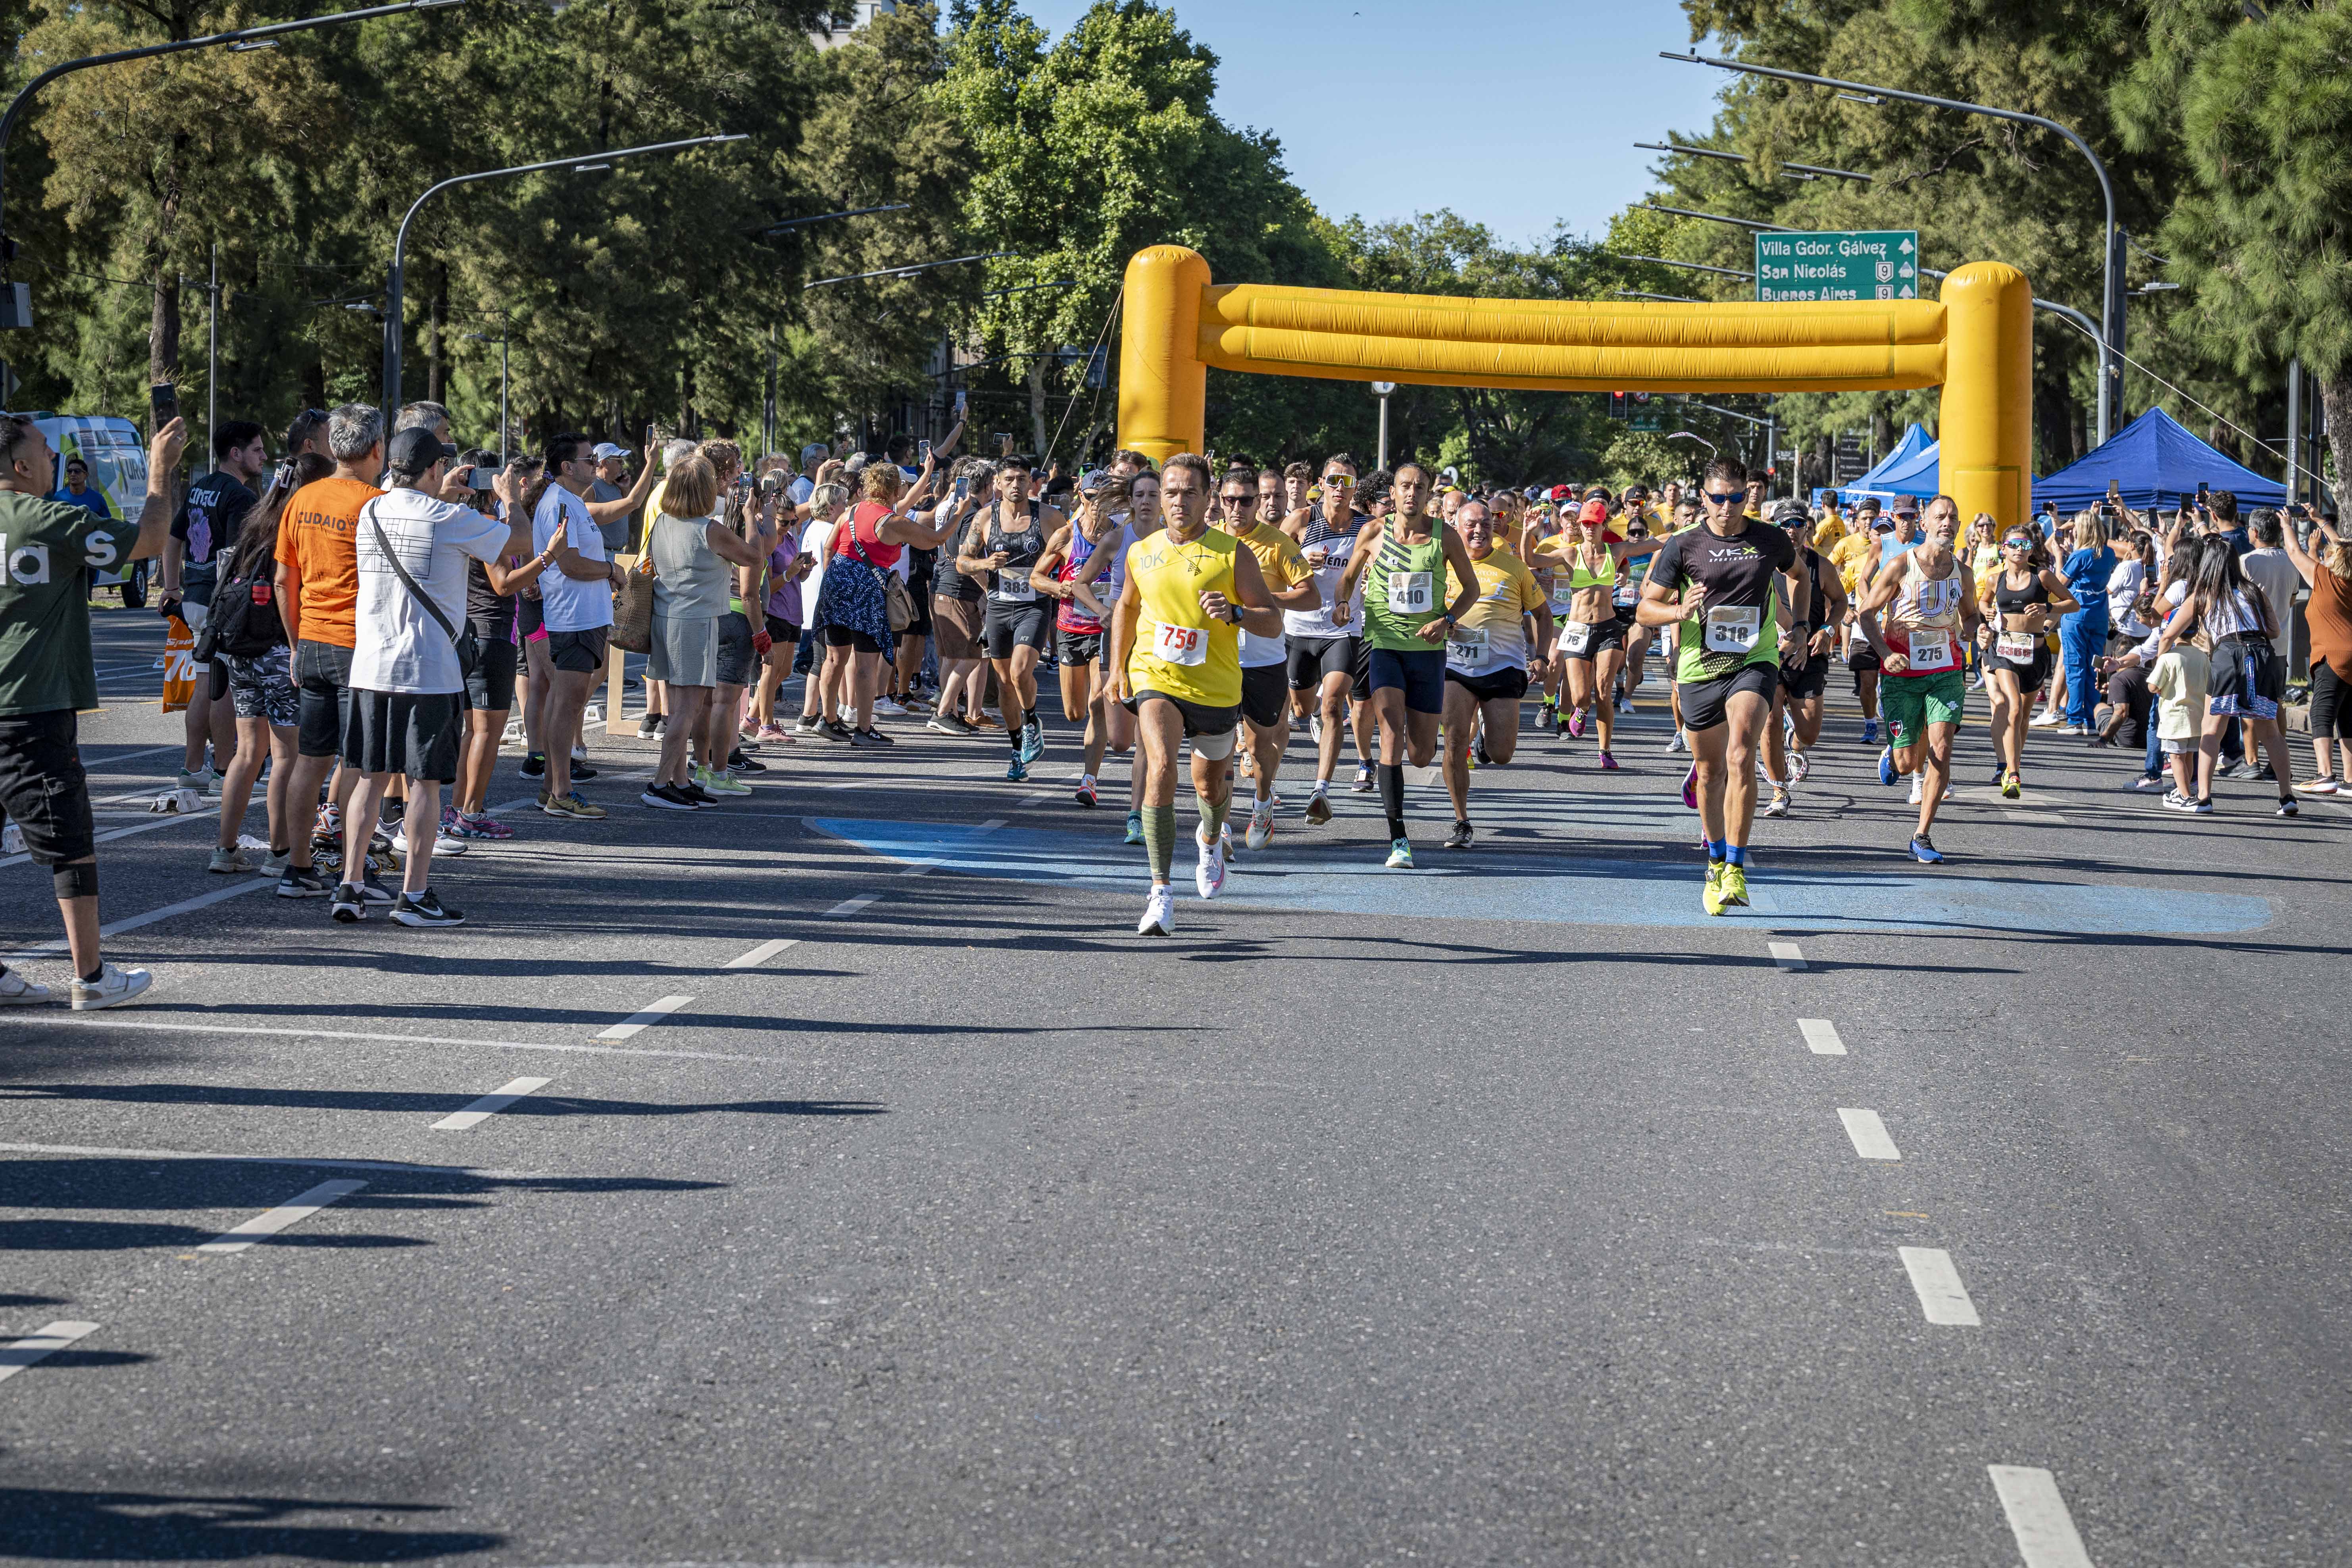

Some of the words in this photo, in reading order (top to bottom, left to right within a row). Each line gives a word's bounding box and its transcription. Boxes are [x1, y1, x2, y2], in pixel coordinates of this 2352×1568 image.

[1761, 241, 1790, 256] Villa
[1796, 240, 1834, 256] Gdor.
[1839, 240, 1887, 257] Gálvez
[1761, 264, 1789, 280] San
[1794, 263, 1847, 278] Nicolás
[1881, 266, 1889, 277] 9
[1762, 287, 1816, 302] Buenos
[1820, 286, 1857, 302] Aires
[1881, 288, 1889, 300] 9
[298, 512, 346, 531] CUDAIO
[1708, 546, 1758, 557] VKX
[1140, 550, 1164, 571] 10K
[1004, 581, 1029, 594] 383
[1396, 590, 1424, 604] 410
[1164, 626, 1198, 651] 759
[1715, 625, 1748, 643] 318
[1455, 645, 1478, 658] 271
[1917, 646, 1943, 662] 275
